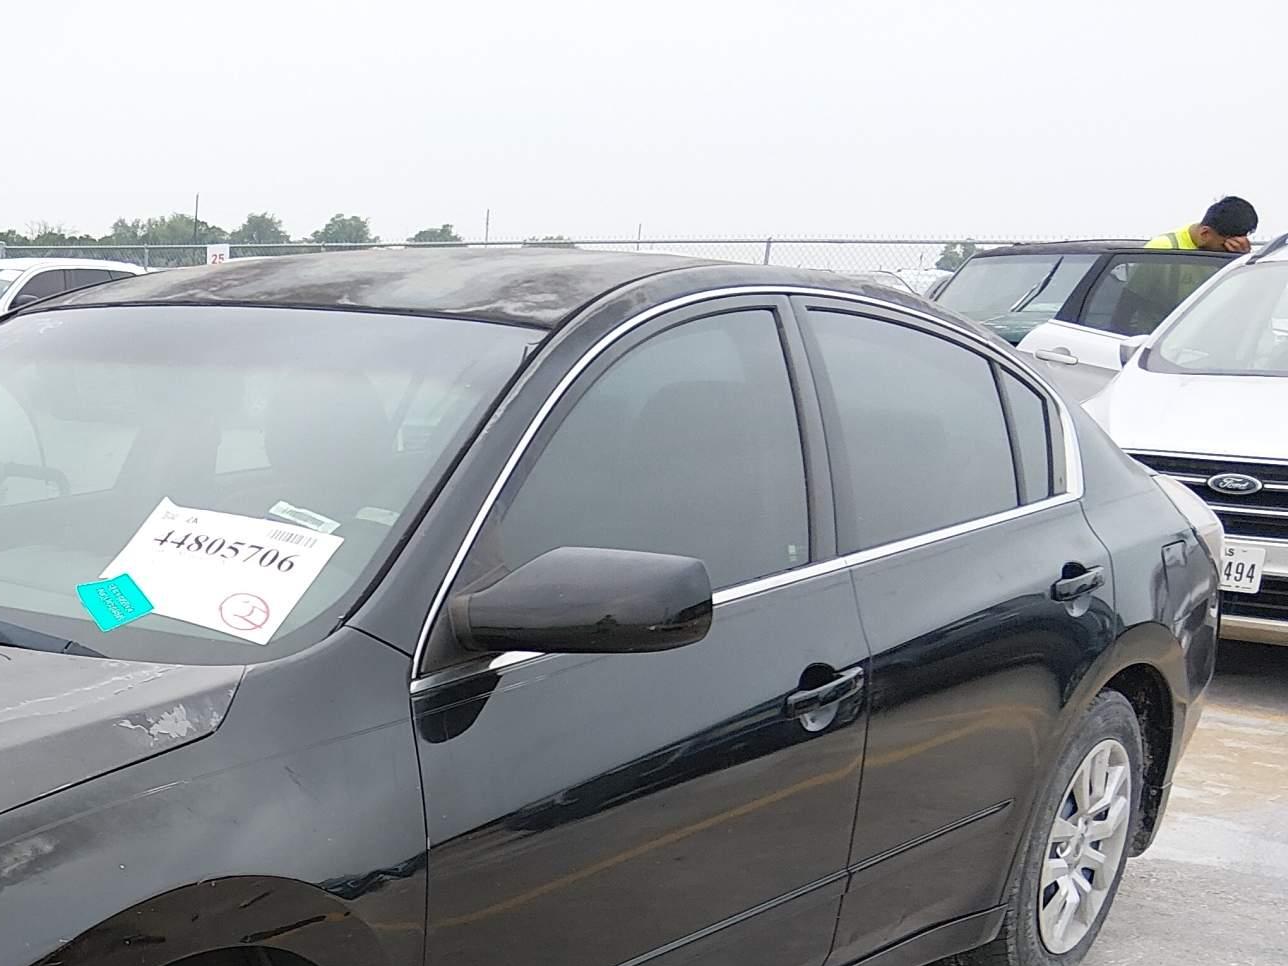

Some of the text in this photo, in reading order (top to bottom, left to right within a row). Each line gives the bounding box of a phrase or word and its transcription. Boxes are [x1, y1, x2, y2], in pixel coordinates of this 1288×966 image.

[1219, 478, 1249, 490] Ford
[154, 529, 301, 573] 44805706
[1224, 561, 1256, 584] 494
